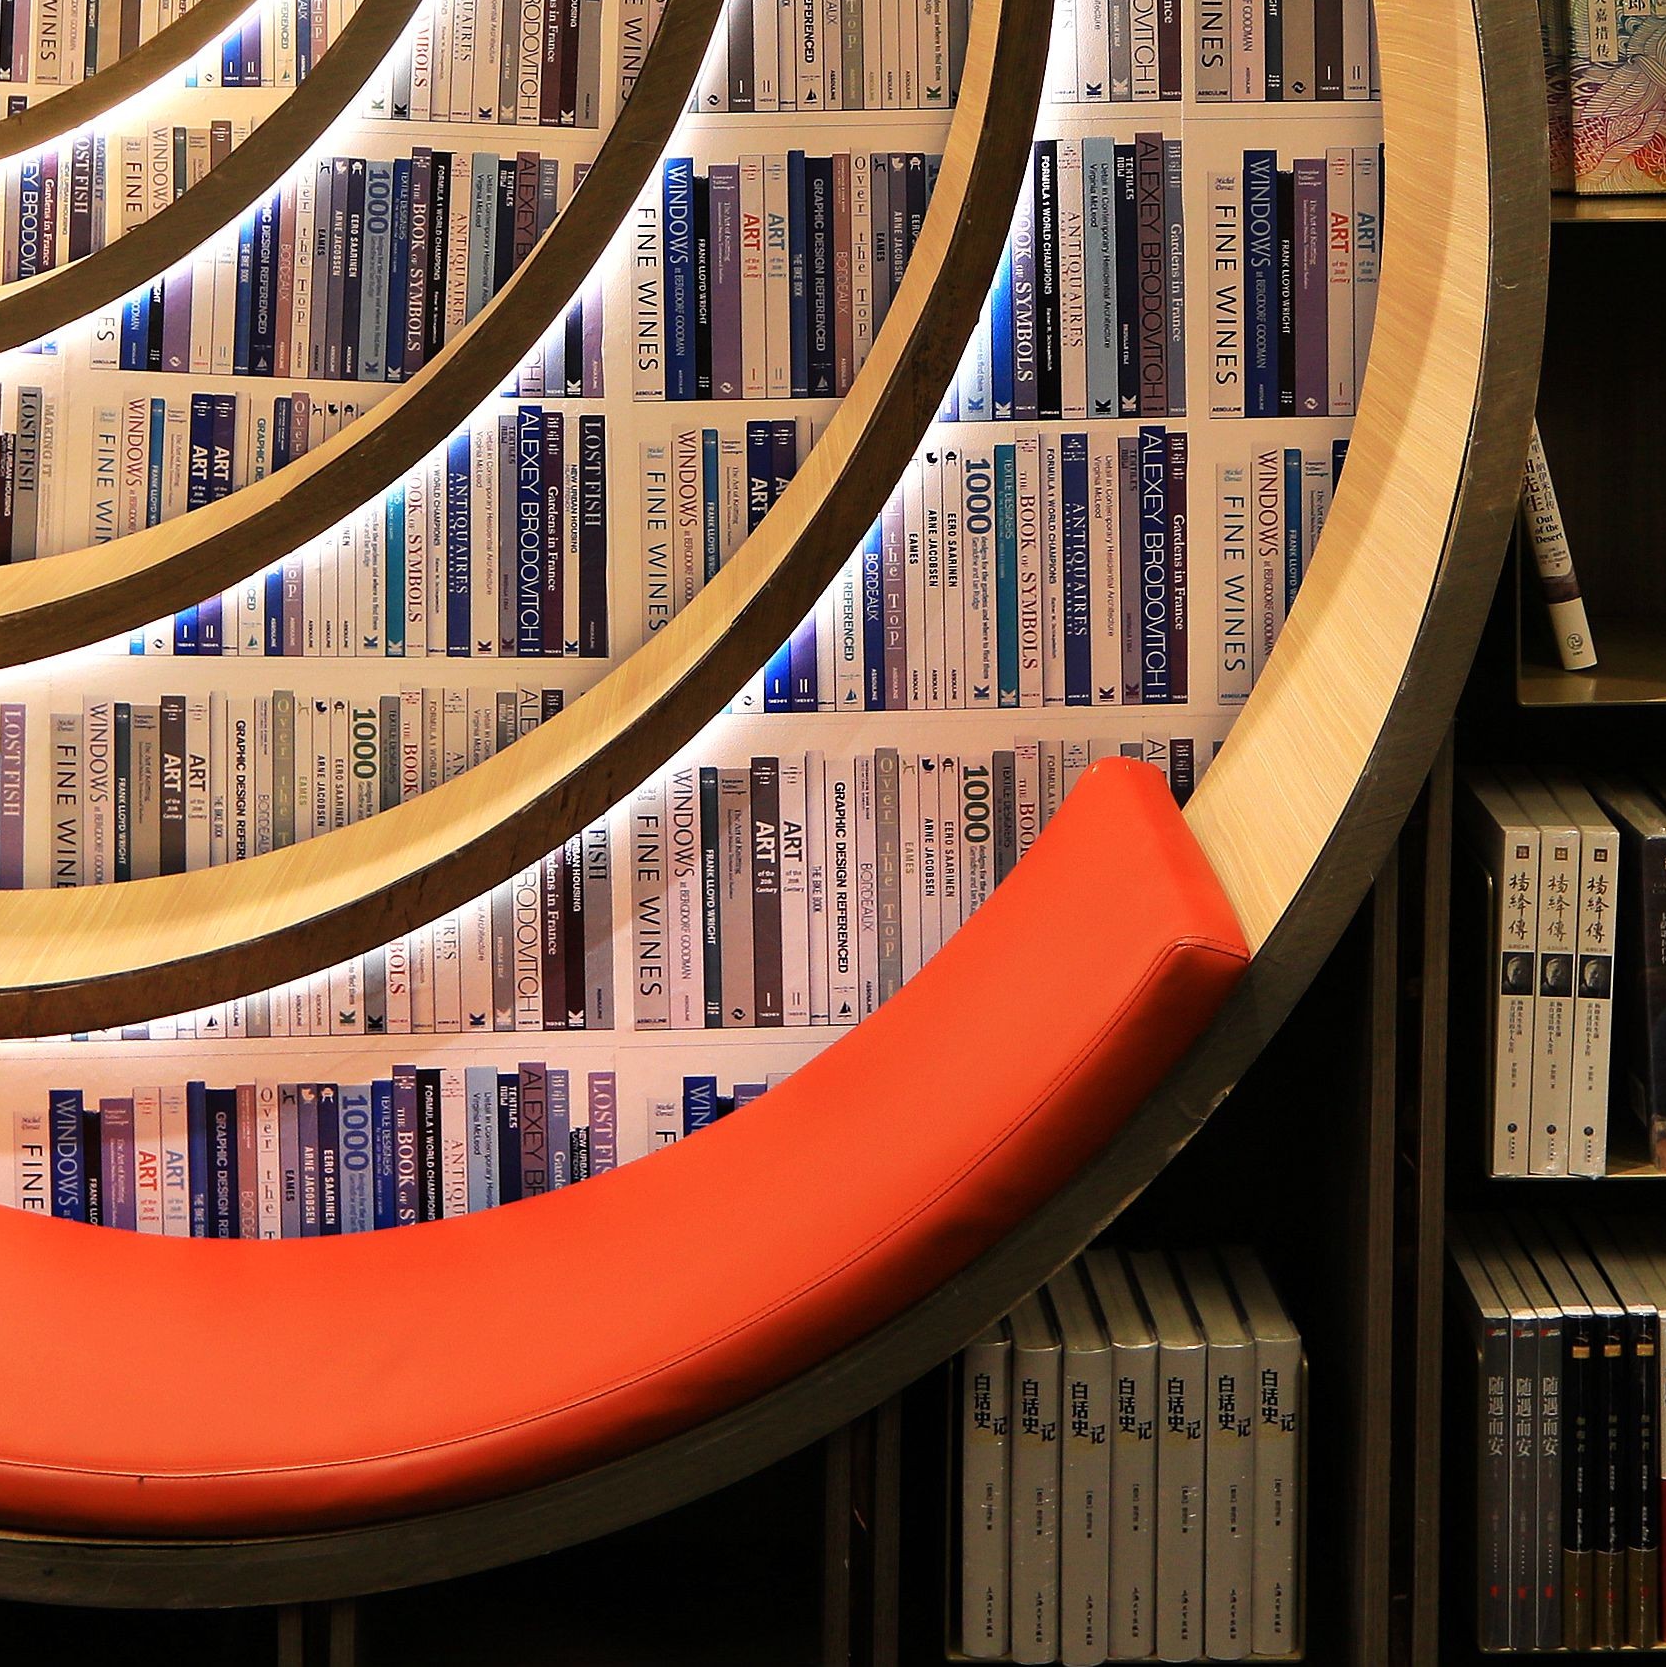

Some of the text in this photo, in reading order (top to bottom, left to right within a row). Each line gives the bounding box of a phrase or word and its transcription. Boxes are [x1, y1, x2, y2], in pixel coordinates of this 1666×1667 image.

[584, 422, 602, 527] LOST FISH
[966, 457, 992, 534] 1000
[521, 411, 540, 642] ALEXEY BRODOVITCH
[1070, 503, 1088, 636] ANTIQUAIRES
[1223, 496, 1246, 672] FINE WINES
[3, 711, 22, 818] LOST FISH
[673, 769, 695, 878] WINDOWS
[755, 820, 776, 864] ART
[784, 820, 804, 862] ART
[637, 815, 662, 996] FINE WINES
[835, 782, 848, 974] GRAPHIC DESIGN REFERENCED
[21, 1142, 46, 1210] FINE
[55, 1096, 79, 1206] WINDOWS
[974, 1373, 1007, 1436] 白话史记
[1071, 1381, 1105, 1444] 白话史记
[1168, 1377, 1201, 1440] 白话史记
[1261, 1368, 1295, 1432] 白话史记
[1488, 1377, 1505, 1457] 随遇而安
[1542, 1377, 1559, 1457] 随遇而安
